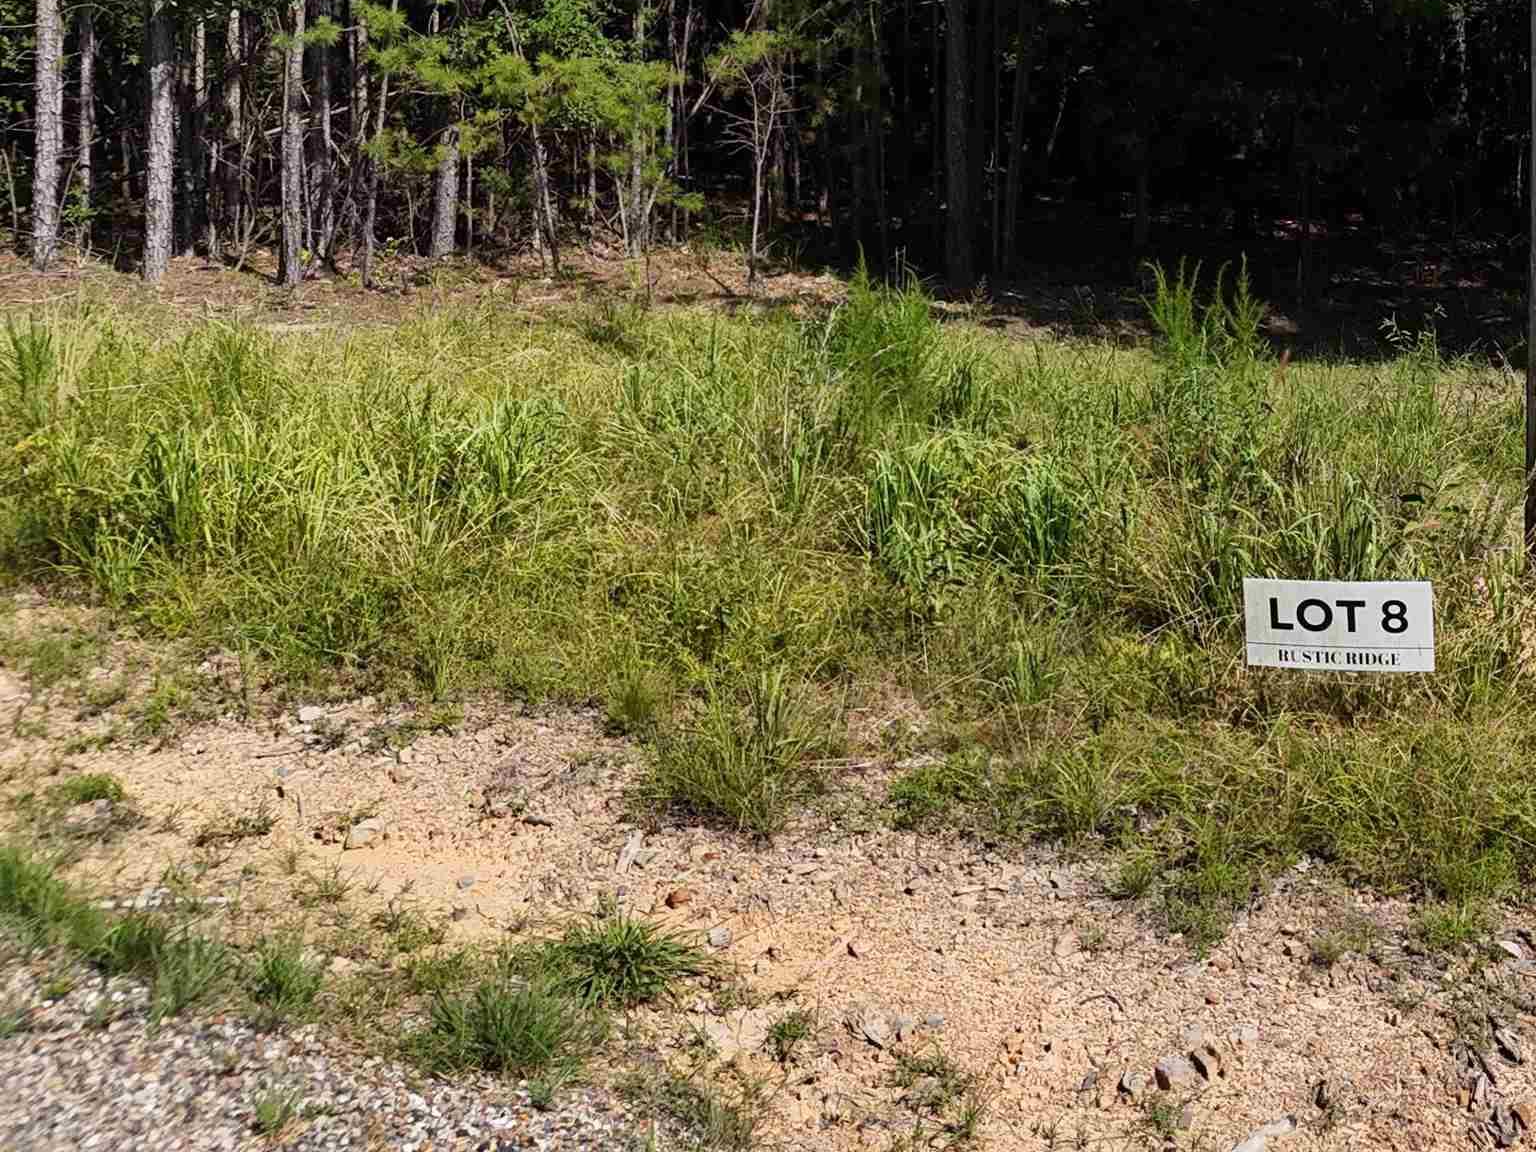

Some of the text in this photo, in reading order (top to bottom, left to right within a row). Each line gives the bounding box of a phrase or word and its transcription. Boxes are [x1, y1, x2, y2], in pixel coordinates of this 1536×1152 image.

[1269, 597, 1409, 634] LOT 8
[1278, 648, 1402, 666] RUSTIC RIDGE
